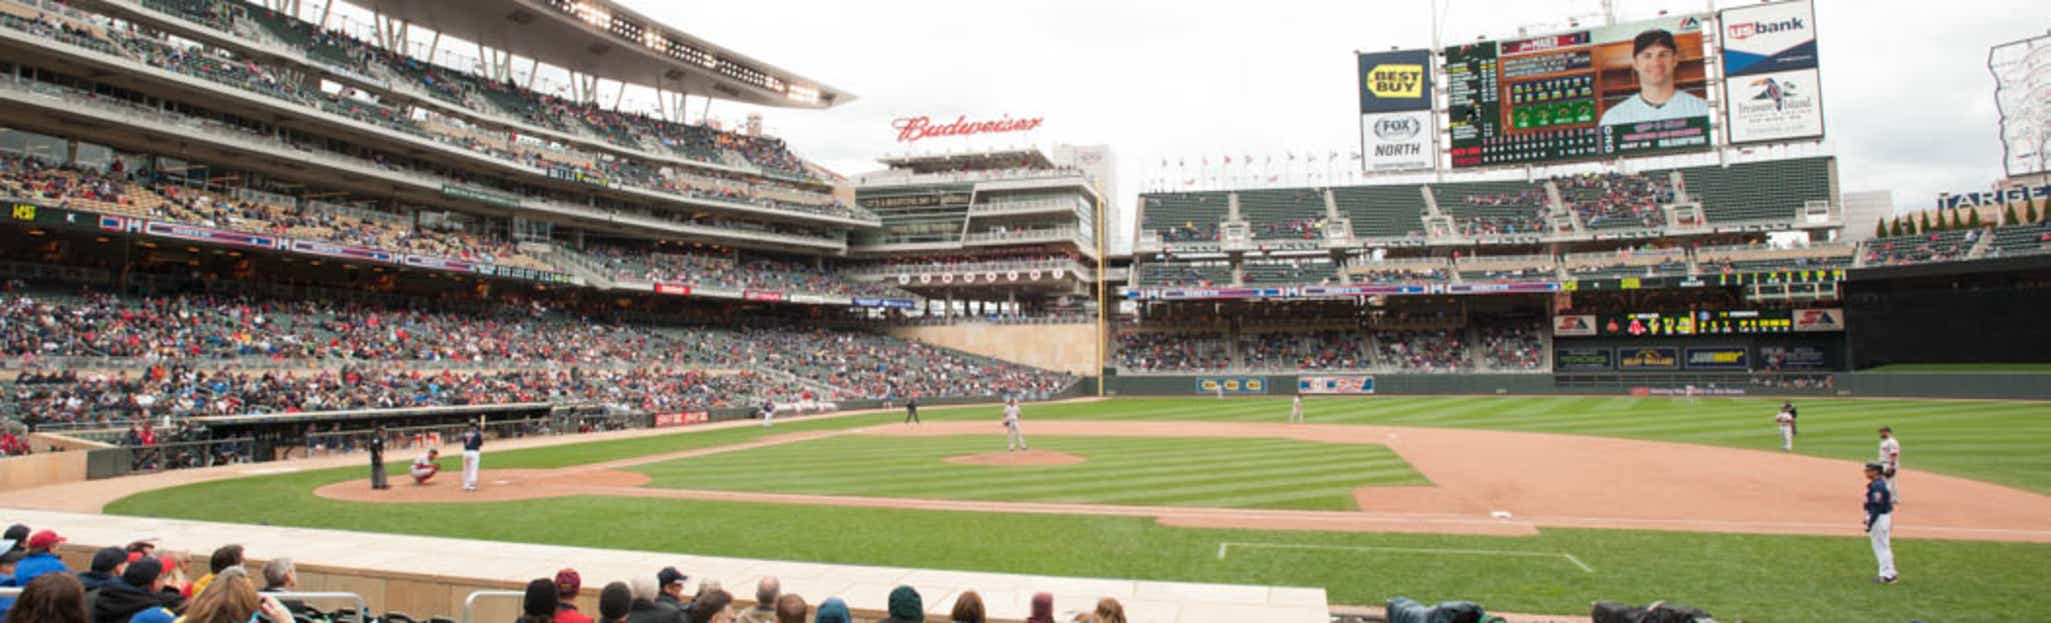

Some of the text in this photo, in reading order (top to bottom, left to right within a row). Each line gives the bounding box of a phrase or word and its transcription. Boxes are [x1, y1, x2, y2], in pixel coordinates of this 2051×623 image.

[1374, 71, 1420, 81] BEST
[1376, 81, 1415, 92] BUY
[892, 113, 1044, 142] Budweiser
[1383, 119, 1410, 131] FOX
[1374, 143, 1421, 157] NORTH
